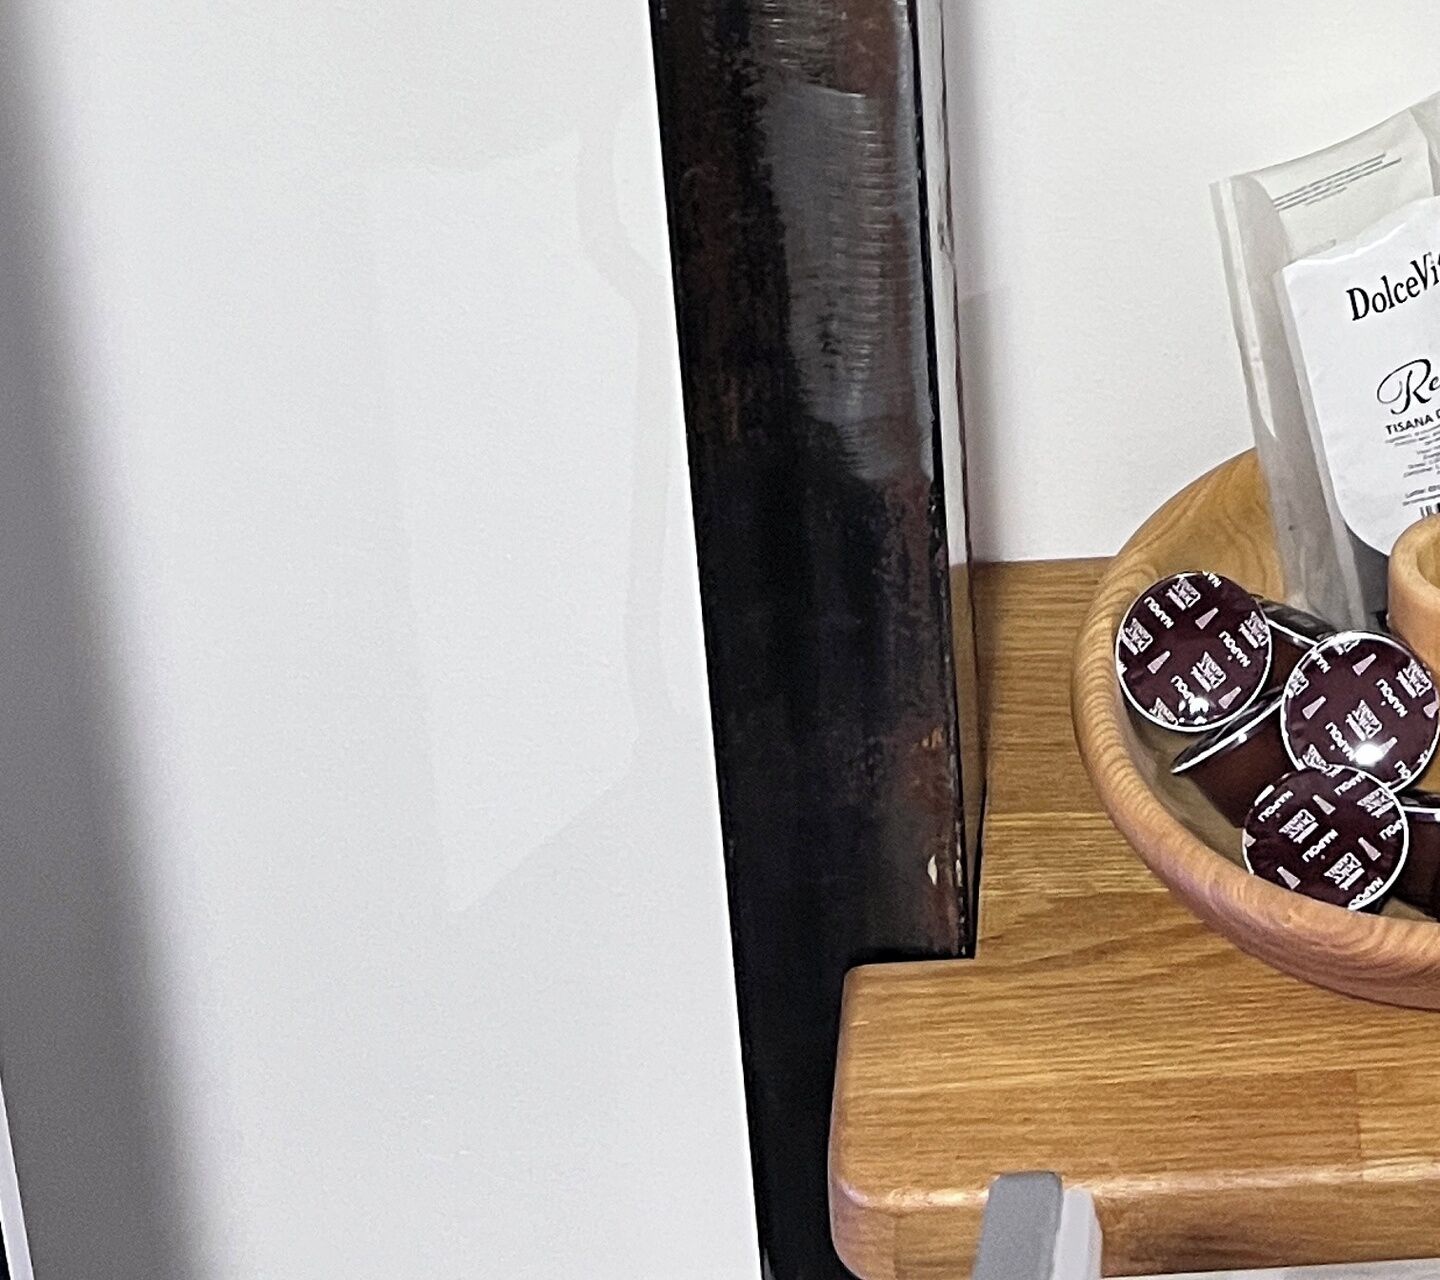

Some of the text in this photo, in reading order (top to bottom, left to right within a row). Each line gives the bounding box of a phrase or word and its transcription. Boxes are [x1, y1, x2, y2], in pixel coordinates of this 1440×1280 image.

[1385, 414, 1434, 435] TISANA
[1143, 595, 1174, 628] NAPOLI
[1218, 630, 1251, 667] NAPOLI
[1375, 677, 1408, 717] NAPOLI
[1257, 789, 1293, 822] NAPOLI
[1300, 828, 1338, 862] NAPOLI
